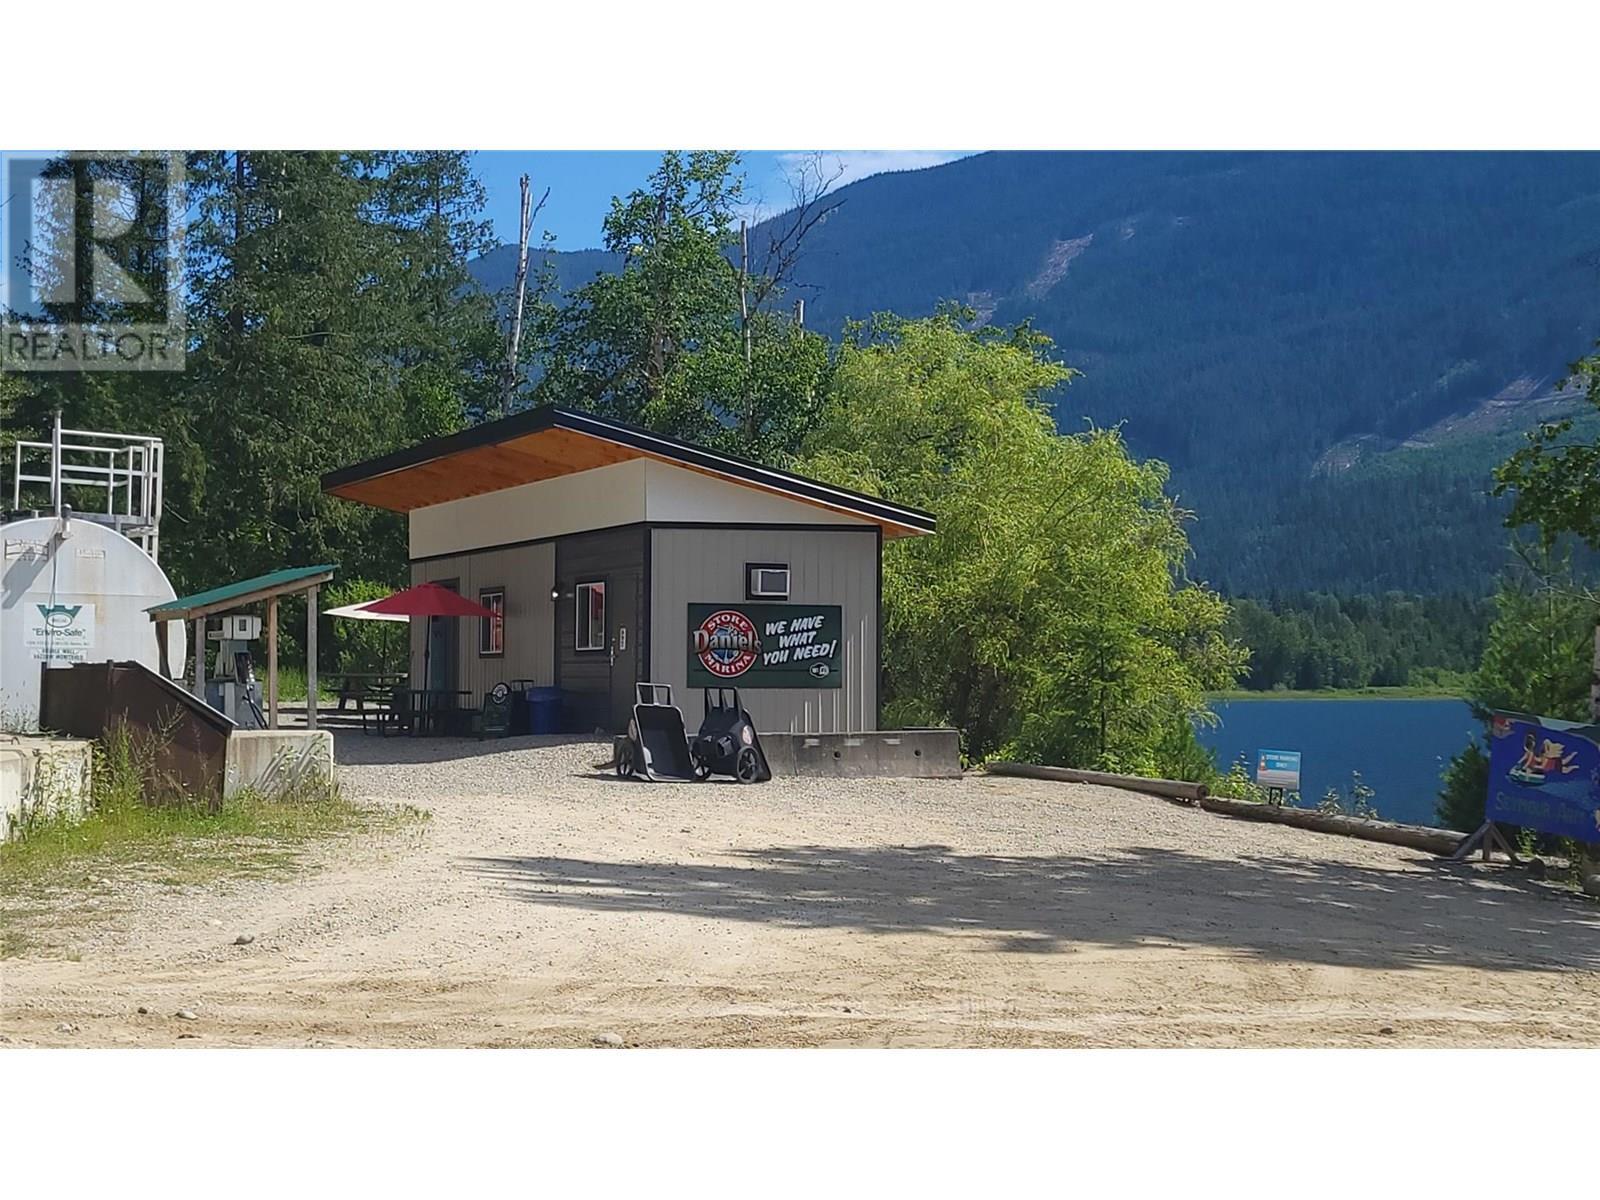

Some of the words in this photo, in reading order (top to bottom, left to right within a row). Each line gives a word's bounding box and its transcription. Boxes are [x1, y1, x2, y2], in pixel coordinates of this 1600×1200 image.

[707, 613, 749, 631] STORE
[765, 620, 788, 636] WE
[790, 615, 825, 633] HAVE
[779, 631, 817, 648] WHAT
[763, 649, 789, 665] YOU
[793, 639, 838, 661] NEED!
[704, 653, 752, 673] MARINA
